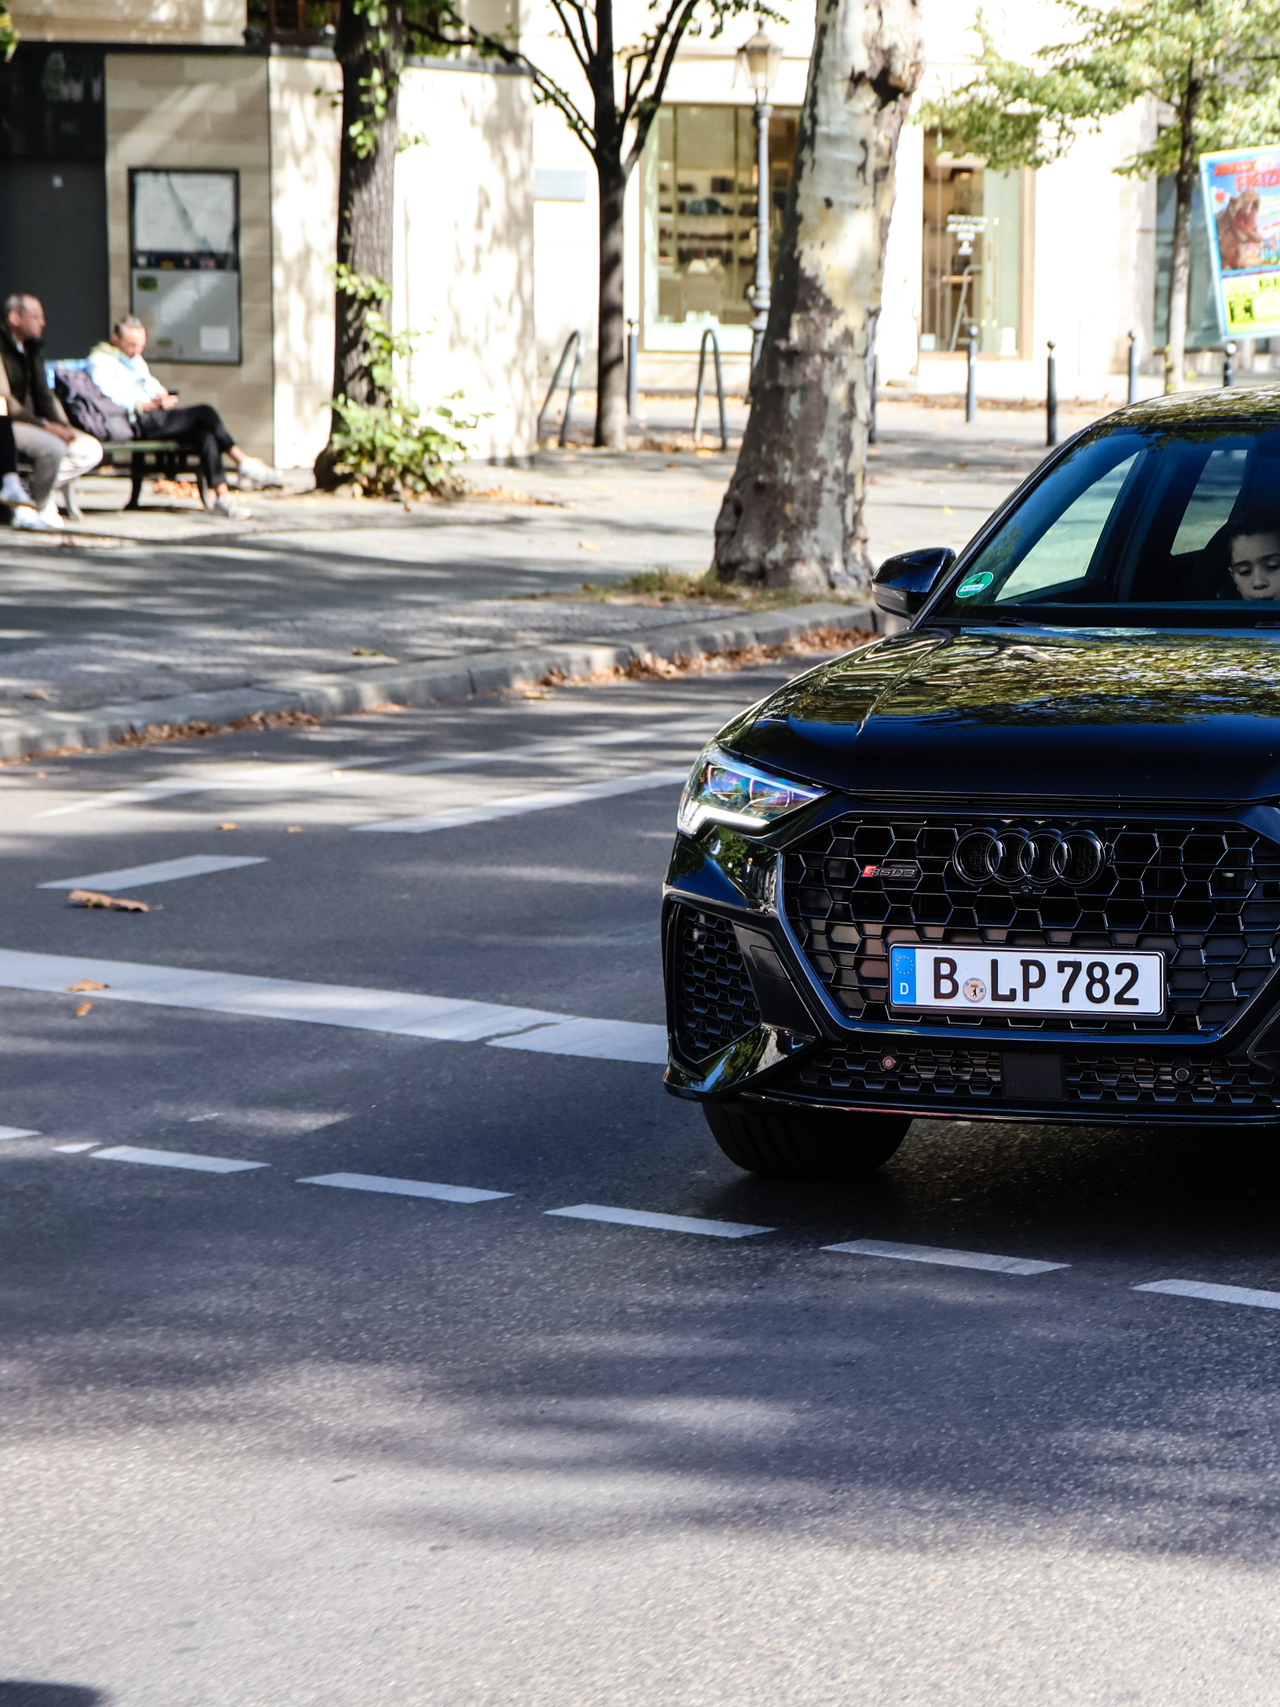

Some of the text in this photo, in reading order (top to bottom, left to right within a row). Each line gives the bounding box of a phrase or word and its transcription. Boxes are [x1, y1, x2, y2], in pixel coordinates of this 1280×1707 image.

[900, 982, 909, 995] D
[933, 956, 959, 1000] B
[990, 958, 1046, 1002] LP
[1056, 960, 1140, 1006] 782
